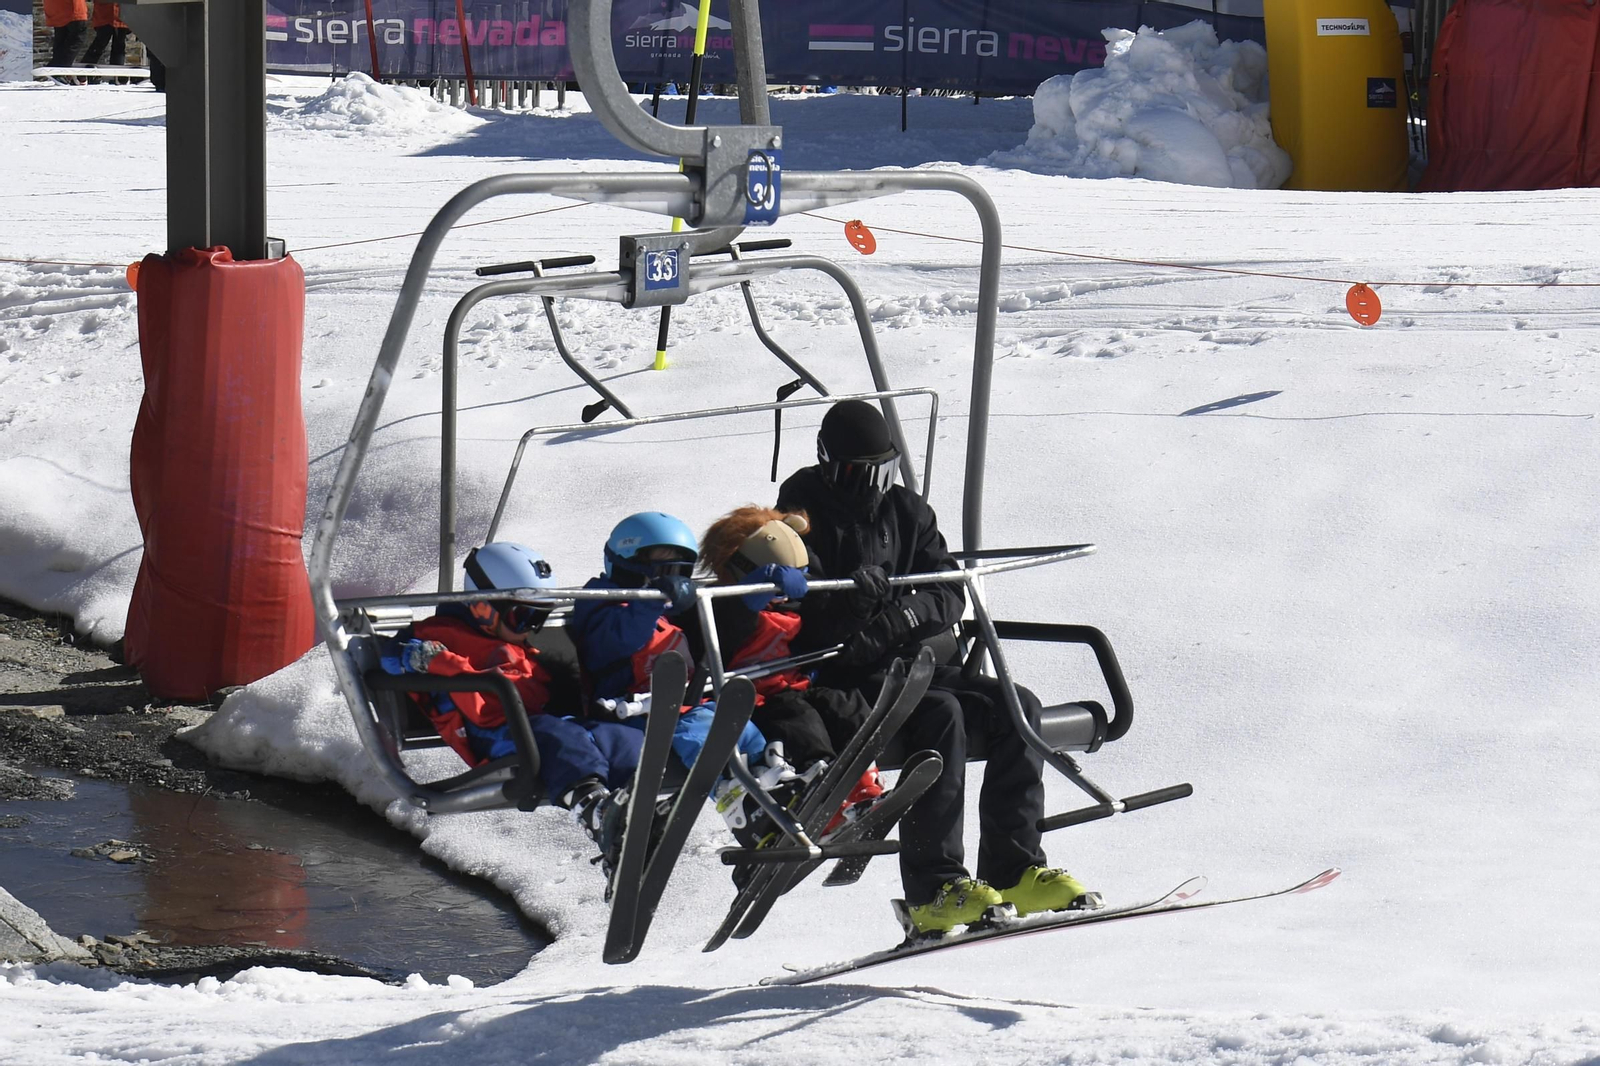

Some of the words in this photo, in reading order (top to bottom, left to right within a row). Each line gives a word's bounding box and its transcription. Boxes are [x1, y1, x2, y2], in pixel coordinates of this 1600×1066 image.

[294, 10, 405, 45] sierra
[413, 14, 567, 46] nevada
[625, 31, 677, 48] sierra
[883, 17, 999, 57] sierra
[753, 182, 776, 211] 30
